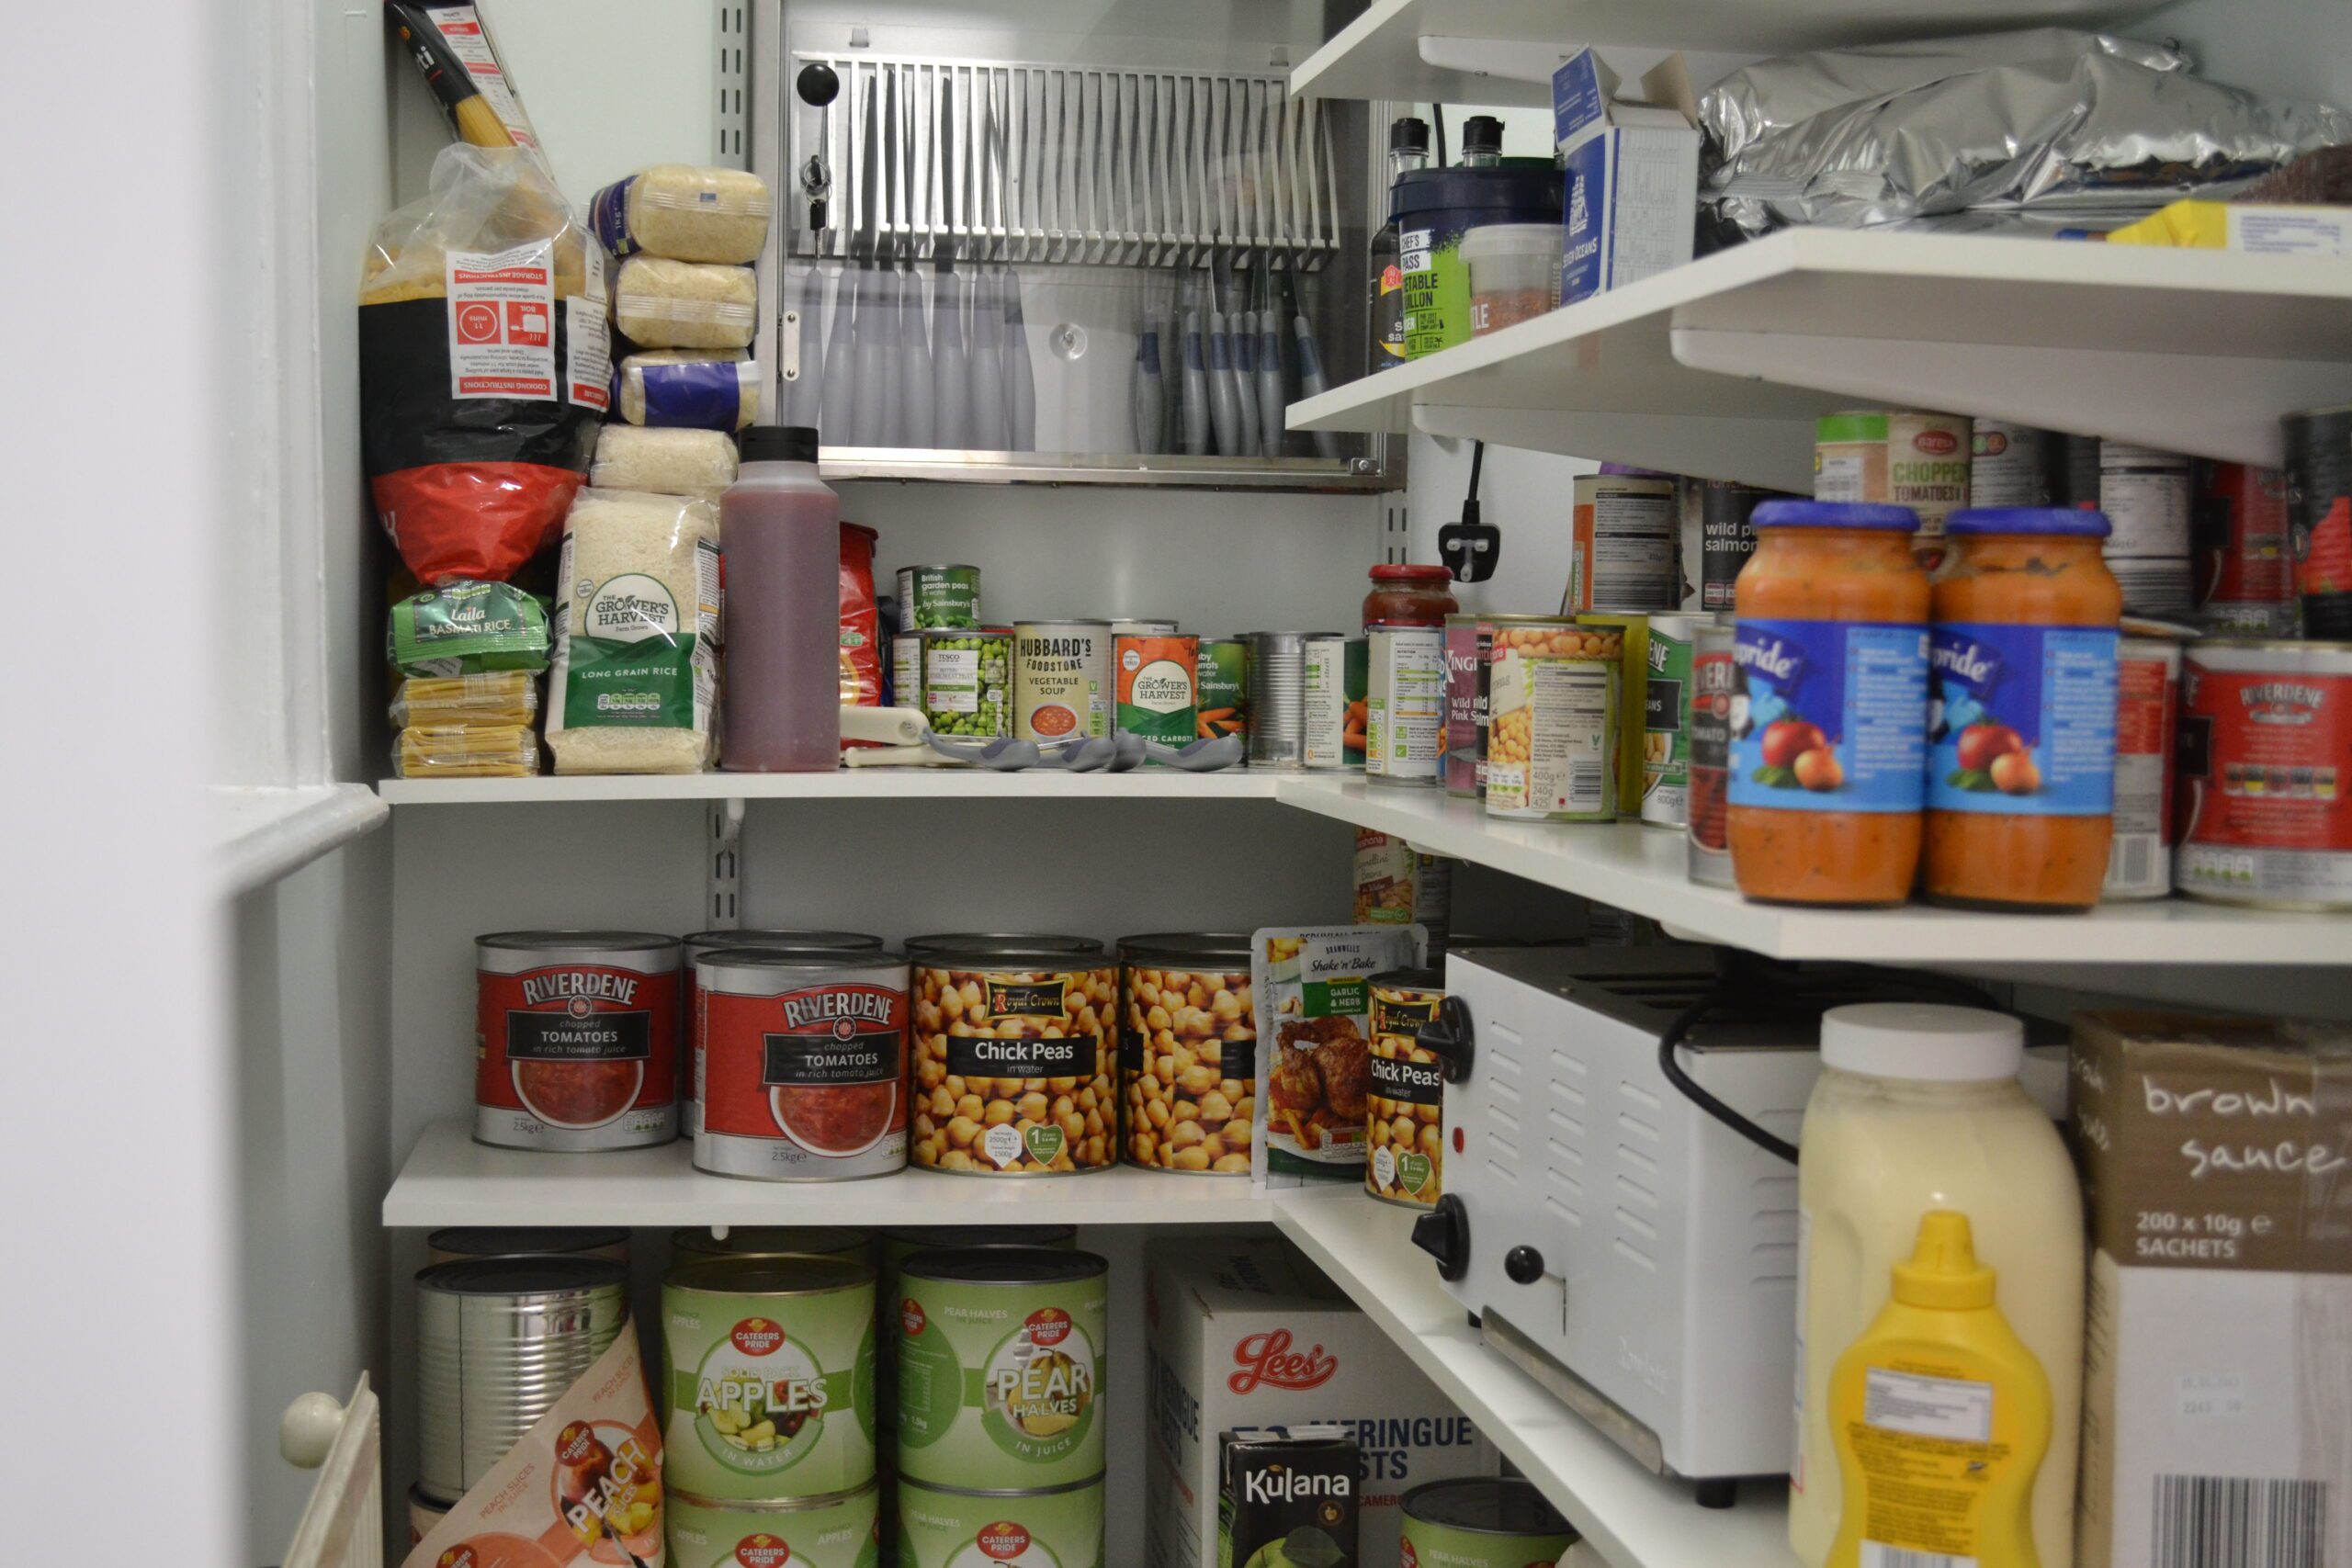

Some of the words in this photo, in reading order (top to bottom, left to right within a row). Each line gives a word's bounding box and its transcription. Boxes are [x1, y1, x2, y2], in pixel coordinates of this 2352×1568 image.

[1401, 235, 1419, 250] CHEF'S
[516, 382, 548, 391] COOKING
[1894, 486, 1953, 502] TOMATOES
[1705, 522, 1736, 536] wild
[921, 574, 943, 582] British
[451, 605, 485, 621] Laila
[595, 596, 669, 615] GROWER'S
[922, 601, 932, 609] by
[598, 612, 665, 626] HARVEST
[429, 622, 481, 636] BASMATI
[484, 619, 511, 632] RICE
[1020, 637, 1091, 658] HUBBARD'S
[582, 671, 611, 679] LONG
[615, 669, 649, 677] GRAIN
[652, 667, 678, 676] RICE
[1026, 658, 1083, 672] FOODSTORE
[1029, 677, 1079, 685] VEGETABLE
[1137, 678, 1187, 690] GROWER'S
[1040, 687, 1066, 695] SOUP
[1139, 691, 1186, 700] HARVEST
[2240, 683, 2326, 709] RIVERDENE
[1452, 697, 1470, 709] Wild
[1452, 711, 1468, 721] Pink
[1532, 772, 1555, 783] 400g
[1532, 786, 1553, 797] 240g
[523, 972, 639, 1005] RIVERDENE
[1330, 987, 1360, 997] GARLIC
[994, 991, 1030, 1012] Royal
[1031, 994, 1059, 1007] Crown
[1340, 998, 1361, 1007] HERB
[783, 992, 893, 1029] RIVERDENE
[560, 1020, 601, 1031] chopped
[540, 1031, 617, 1043] TOMATOES
[544, 1044, 562, 1053] rich
[566, 1044, 601, 1053] tomato
[603, 1043, 626, 1054] juice
[824, 1042, 864, 1051] chopped
[975, 1042, 1028, 1060] Chick
[1033, 1043, 1073, 1060] Peas
[805, 1053, 878, 1067] TOMATOES
[796, 1070, 805, 1078] in
[808, 1069, 827, 1077] rich
[831, 1068, 864, 1077] tomato
[865, 1067, 884, 1078] juice
[1014, 1066, 1044, 1074] water
[1372, 1058, 1399, 1082] Chick
[1402, 1066, 1440, 1086] Peas
[1393, 1088, 1411, 1097] water
[2143, 1076, 2317, 1115] brown
[1032, 1129, 1039, 1145] 1
[772, 1152, 797, 1165] 2.5kg
[1402, 1156, 1408, 1172] 1
[2180, 1141, 2348, 1178] sauce
[2136, 1213, 2177, 1233] 200
[2182, 1218, 2196, 1233] x
[2203, 1213, 2242, 1235] 10g
[2136, 1238, 2236, 1258] SACHETS
[944, 1306, 967, 1317] PEAR
[970, 1309, 1008, 1319] HALVES
[673, 1314, 700, 1330] APPLES
[1029, 1321, 1068, 1332] CATERERS
[736, 1332, 779, 1340] CATERERS
[1036, 1330, 1060, 1338] PRIDE
[613, 1353, 634, 1382] SLICES
[998, 1363, 1088, 1401] PEAR
[695, 1378, 828, 1413] APPLES
[1013, 1398, 1077, 1418] HALVES
[1310, 1416, 1472, 1449] ERINGUE
[562, 1428, 590, 1460] CATERERS
[573, 1440, 589, 1459] PRIDE
[1015, 1440, 1031, 1453] IN
[1036, 1438, 1071, 1457] JUICE
[722, 1448, 736, 1461] IN
[744, 1450, 792, 1467] WATER
[481, 1489, 509, 1519] PEACH
[507, 1462, 535, 1494] SLICES
[508, 1482, 529, 1506] JUICE
[566, 1438, 645, 1534] PEACH
[1246, 1468, 1350, 1505] Kulana
[609, 1483, 638, 1517] SLICES
[929, 1516, 961, 1529] HALVES
[818, 1529, 853, 1545] APPLES
